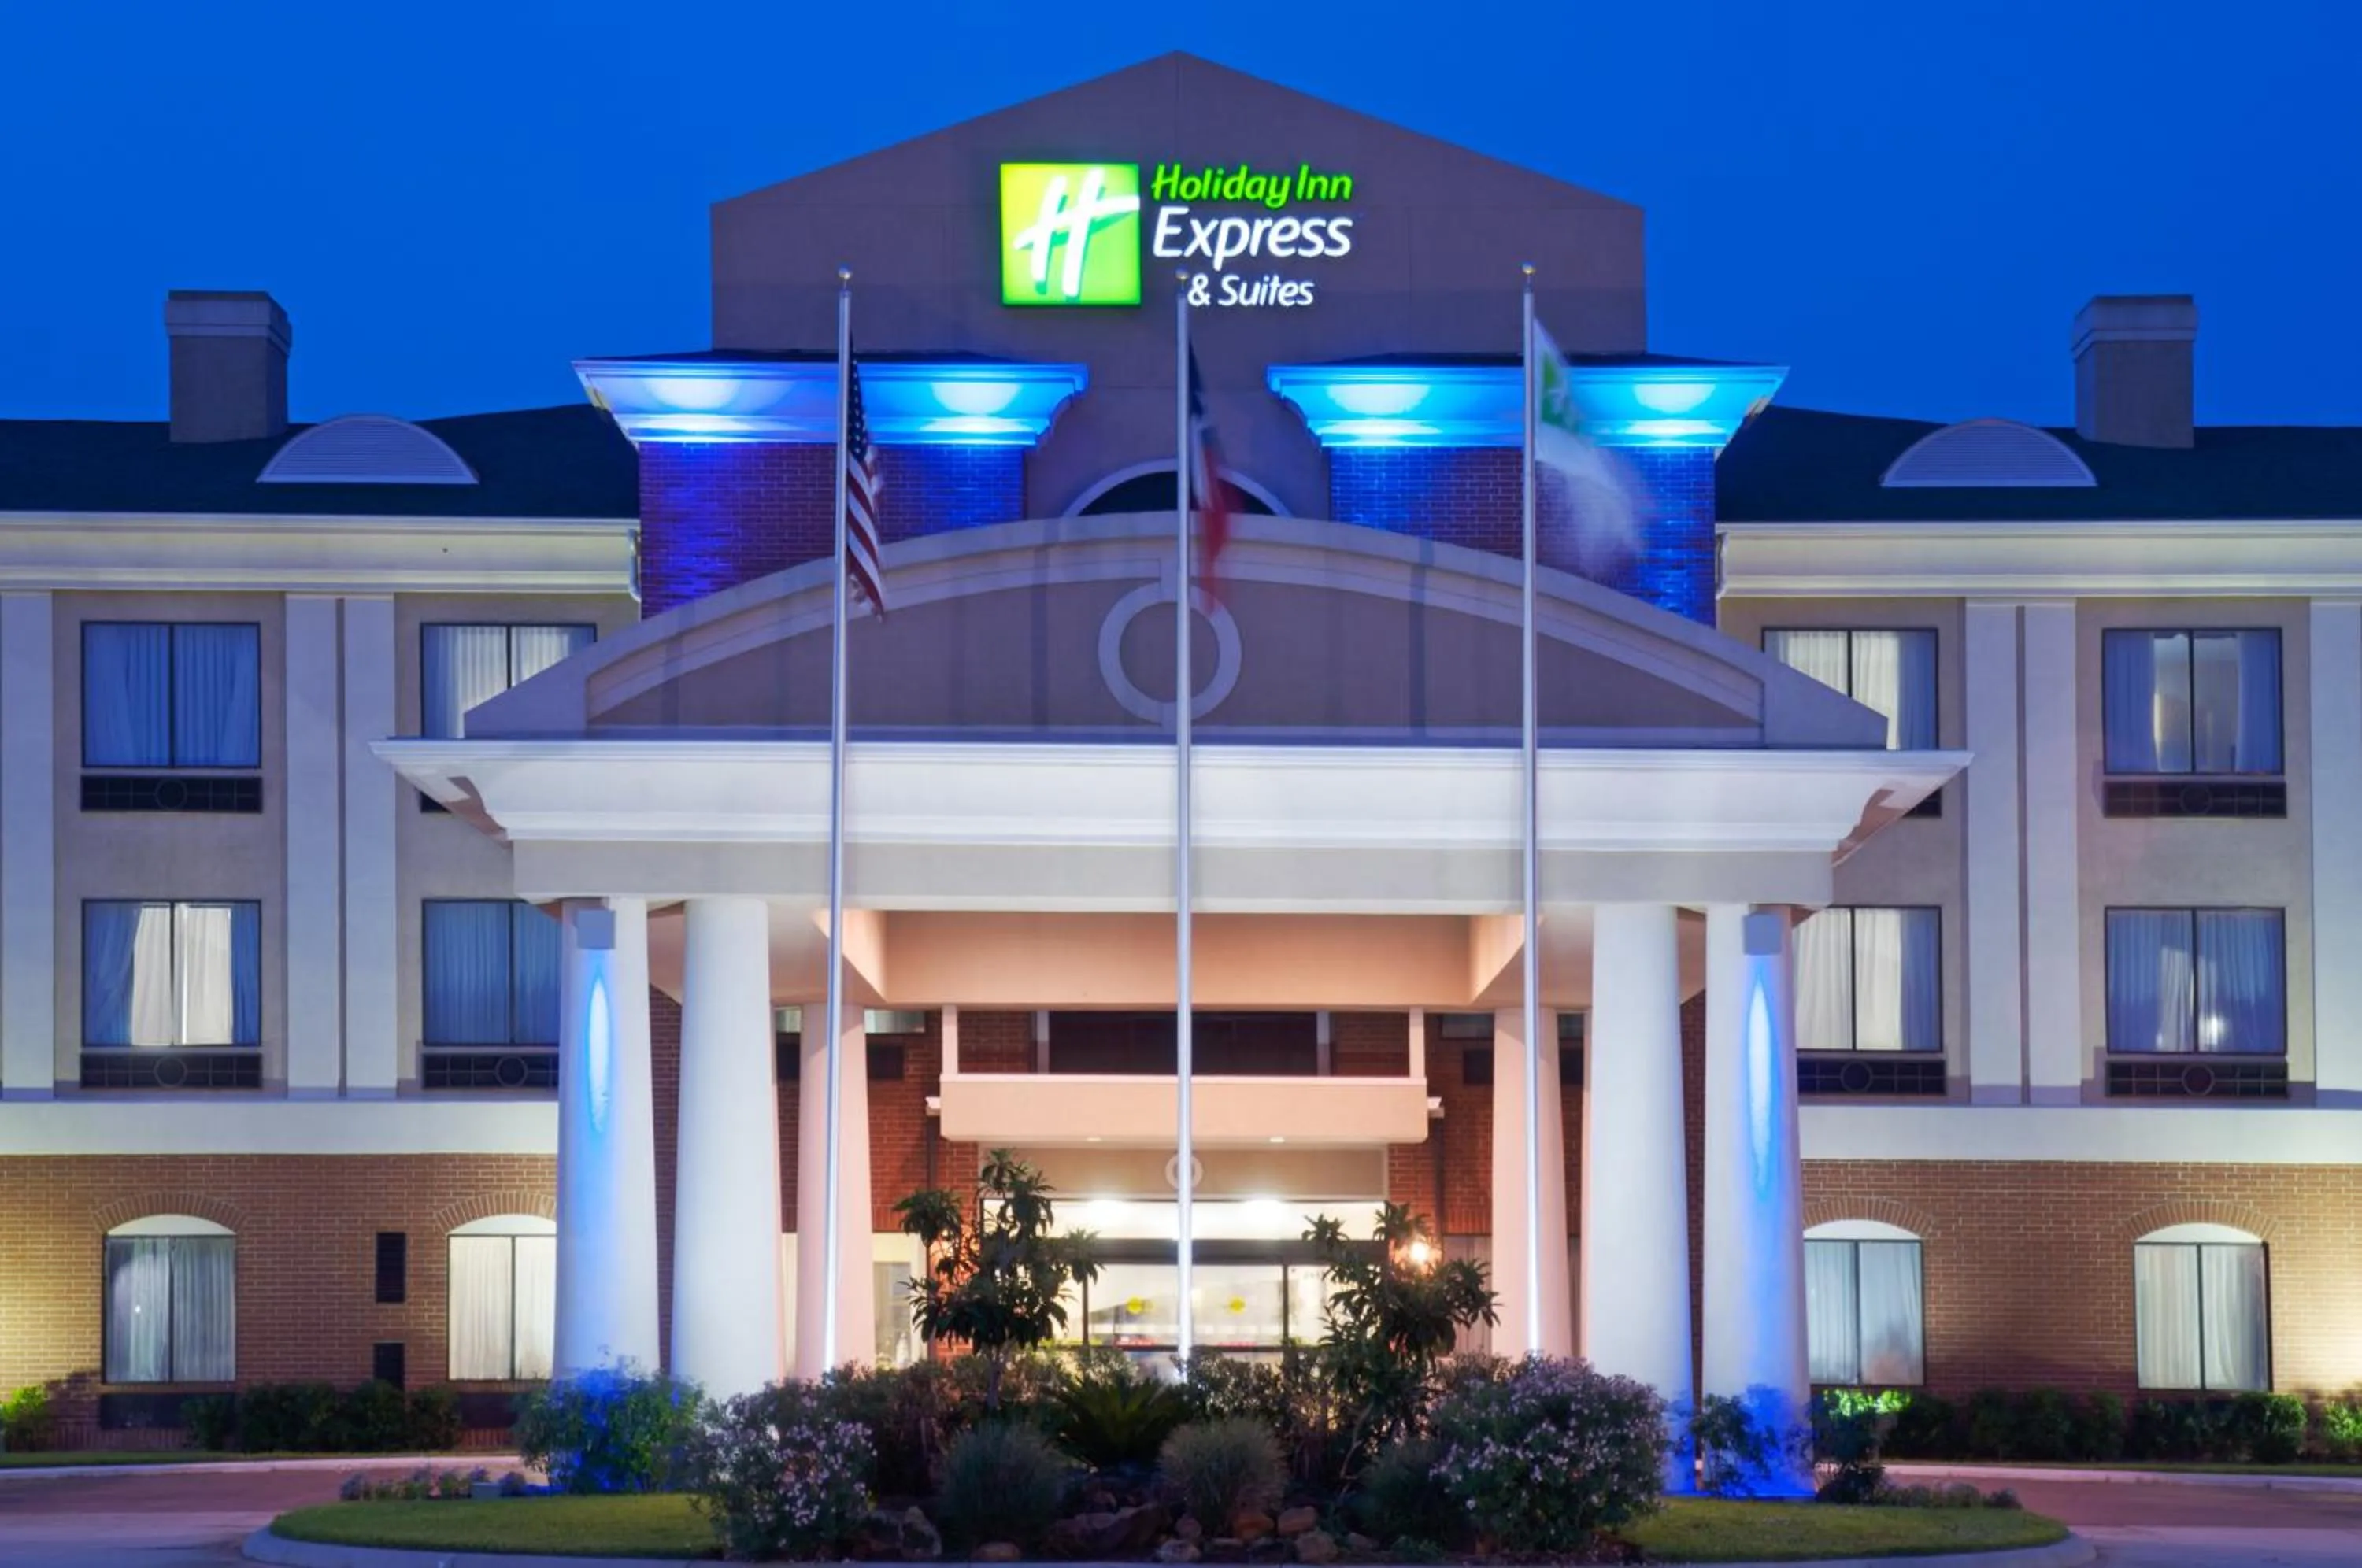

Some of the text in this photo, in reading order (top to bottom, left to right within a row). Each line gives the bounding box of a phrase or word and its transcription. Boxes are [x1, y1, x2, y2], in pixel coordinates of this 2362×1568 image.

[1151, 163, 1353, 208] Holiday Inn
[1153, 205, 1353, 271] Express
[1187, 273, 1315, 306] & Suites
